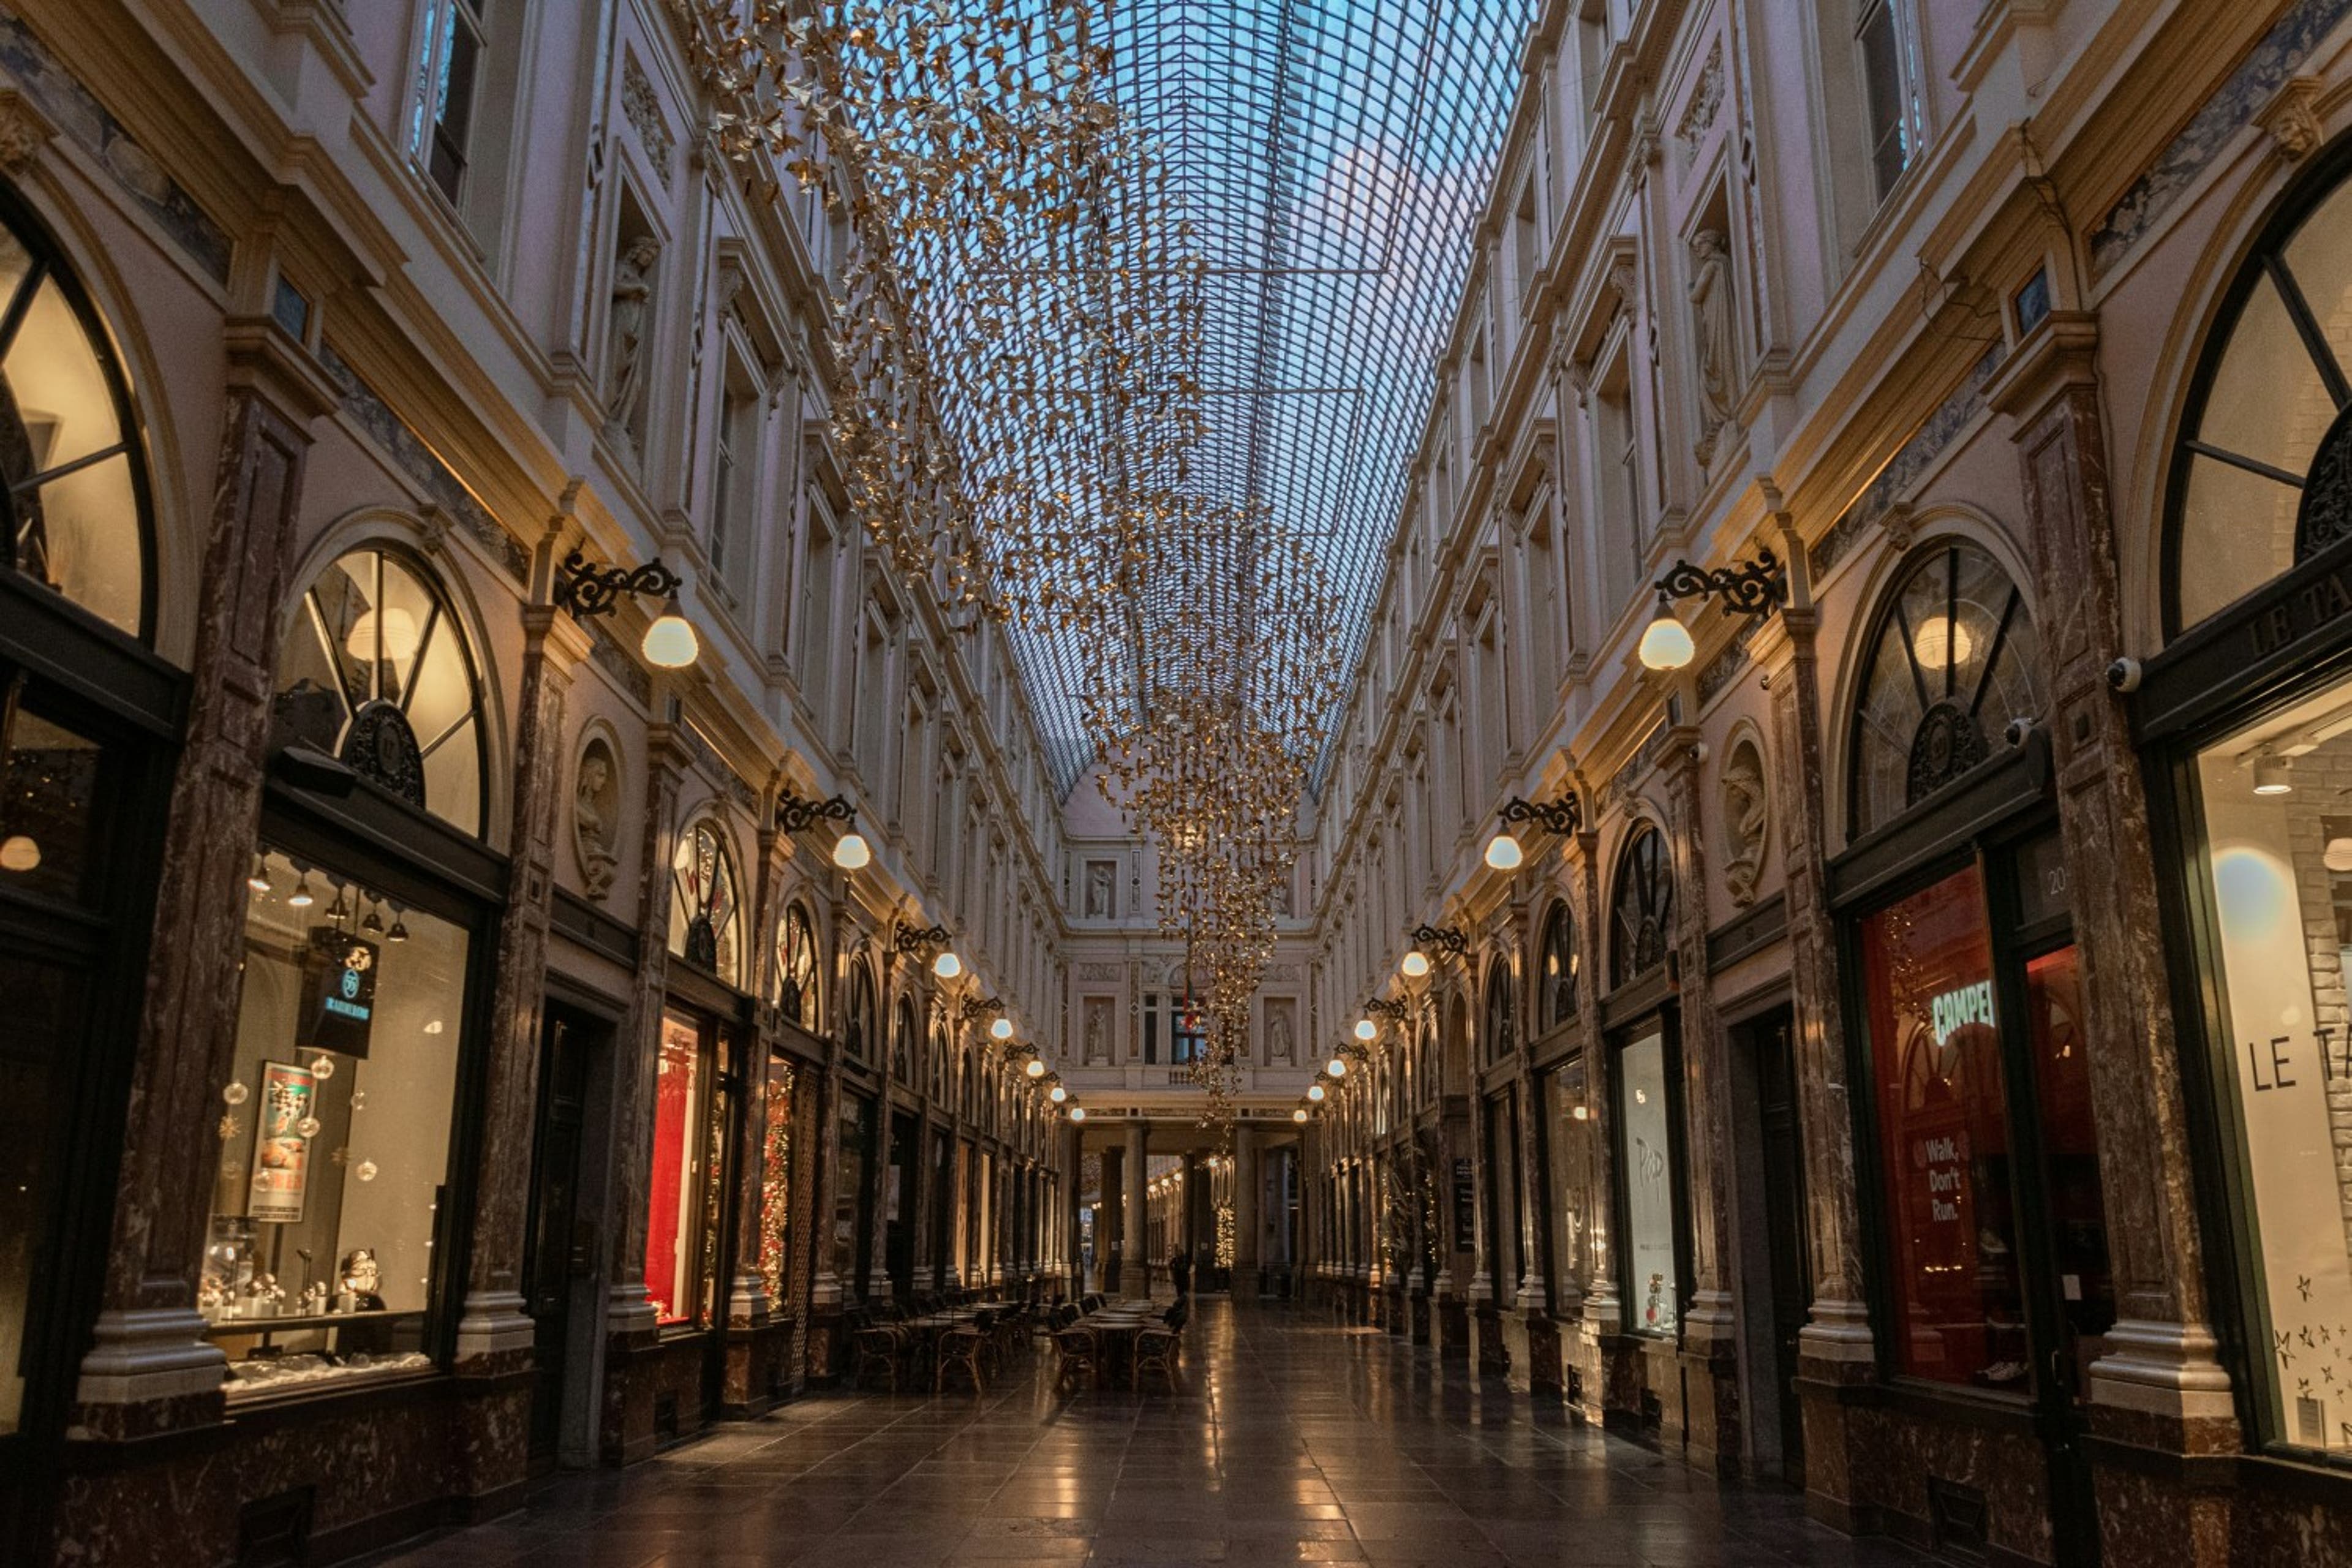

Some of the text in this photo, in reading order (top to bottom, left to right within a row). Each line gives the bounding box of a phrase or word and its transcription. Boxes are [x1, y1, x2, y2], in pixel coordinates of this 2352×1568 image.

[2246, 604, 2293, 657] LE
[2249, 1036, 2296, 1091] LE
[1925, 1136, 1959, 1163] Walk,
[1929, 1166, 1962, 1193] Don't
[1931, 1198, 1959, 1223] Run.
